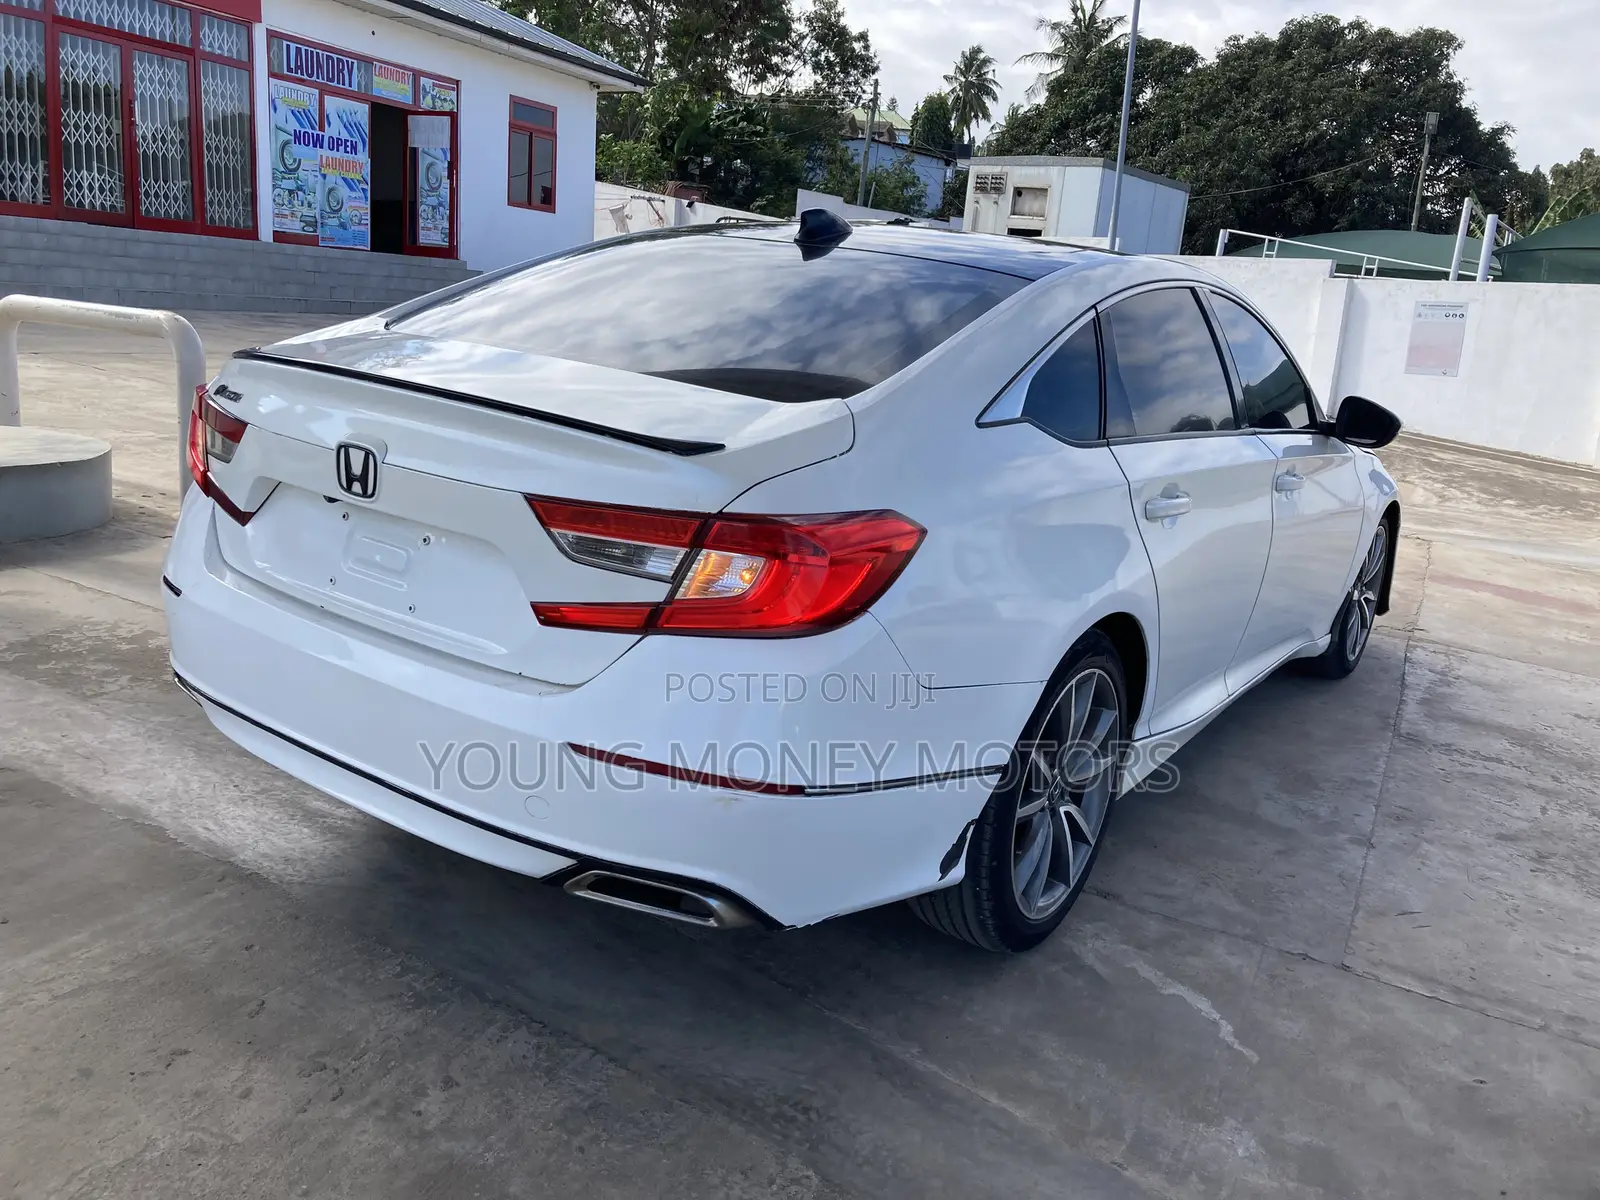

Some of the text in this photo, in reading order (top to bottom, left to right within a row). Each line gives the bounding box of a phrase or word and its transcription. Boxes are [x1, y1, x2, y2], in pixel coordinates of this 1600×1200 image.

[286, 43, 355, 88] LAUNDRY
[374, 63, 412, 86] LAUNDRY
[273, 83, 317, 108] LAUNDRY
[293, 129, 358, 155] NOW OPEN
[319, 154, 364, 174] LAUNDRY
